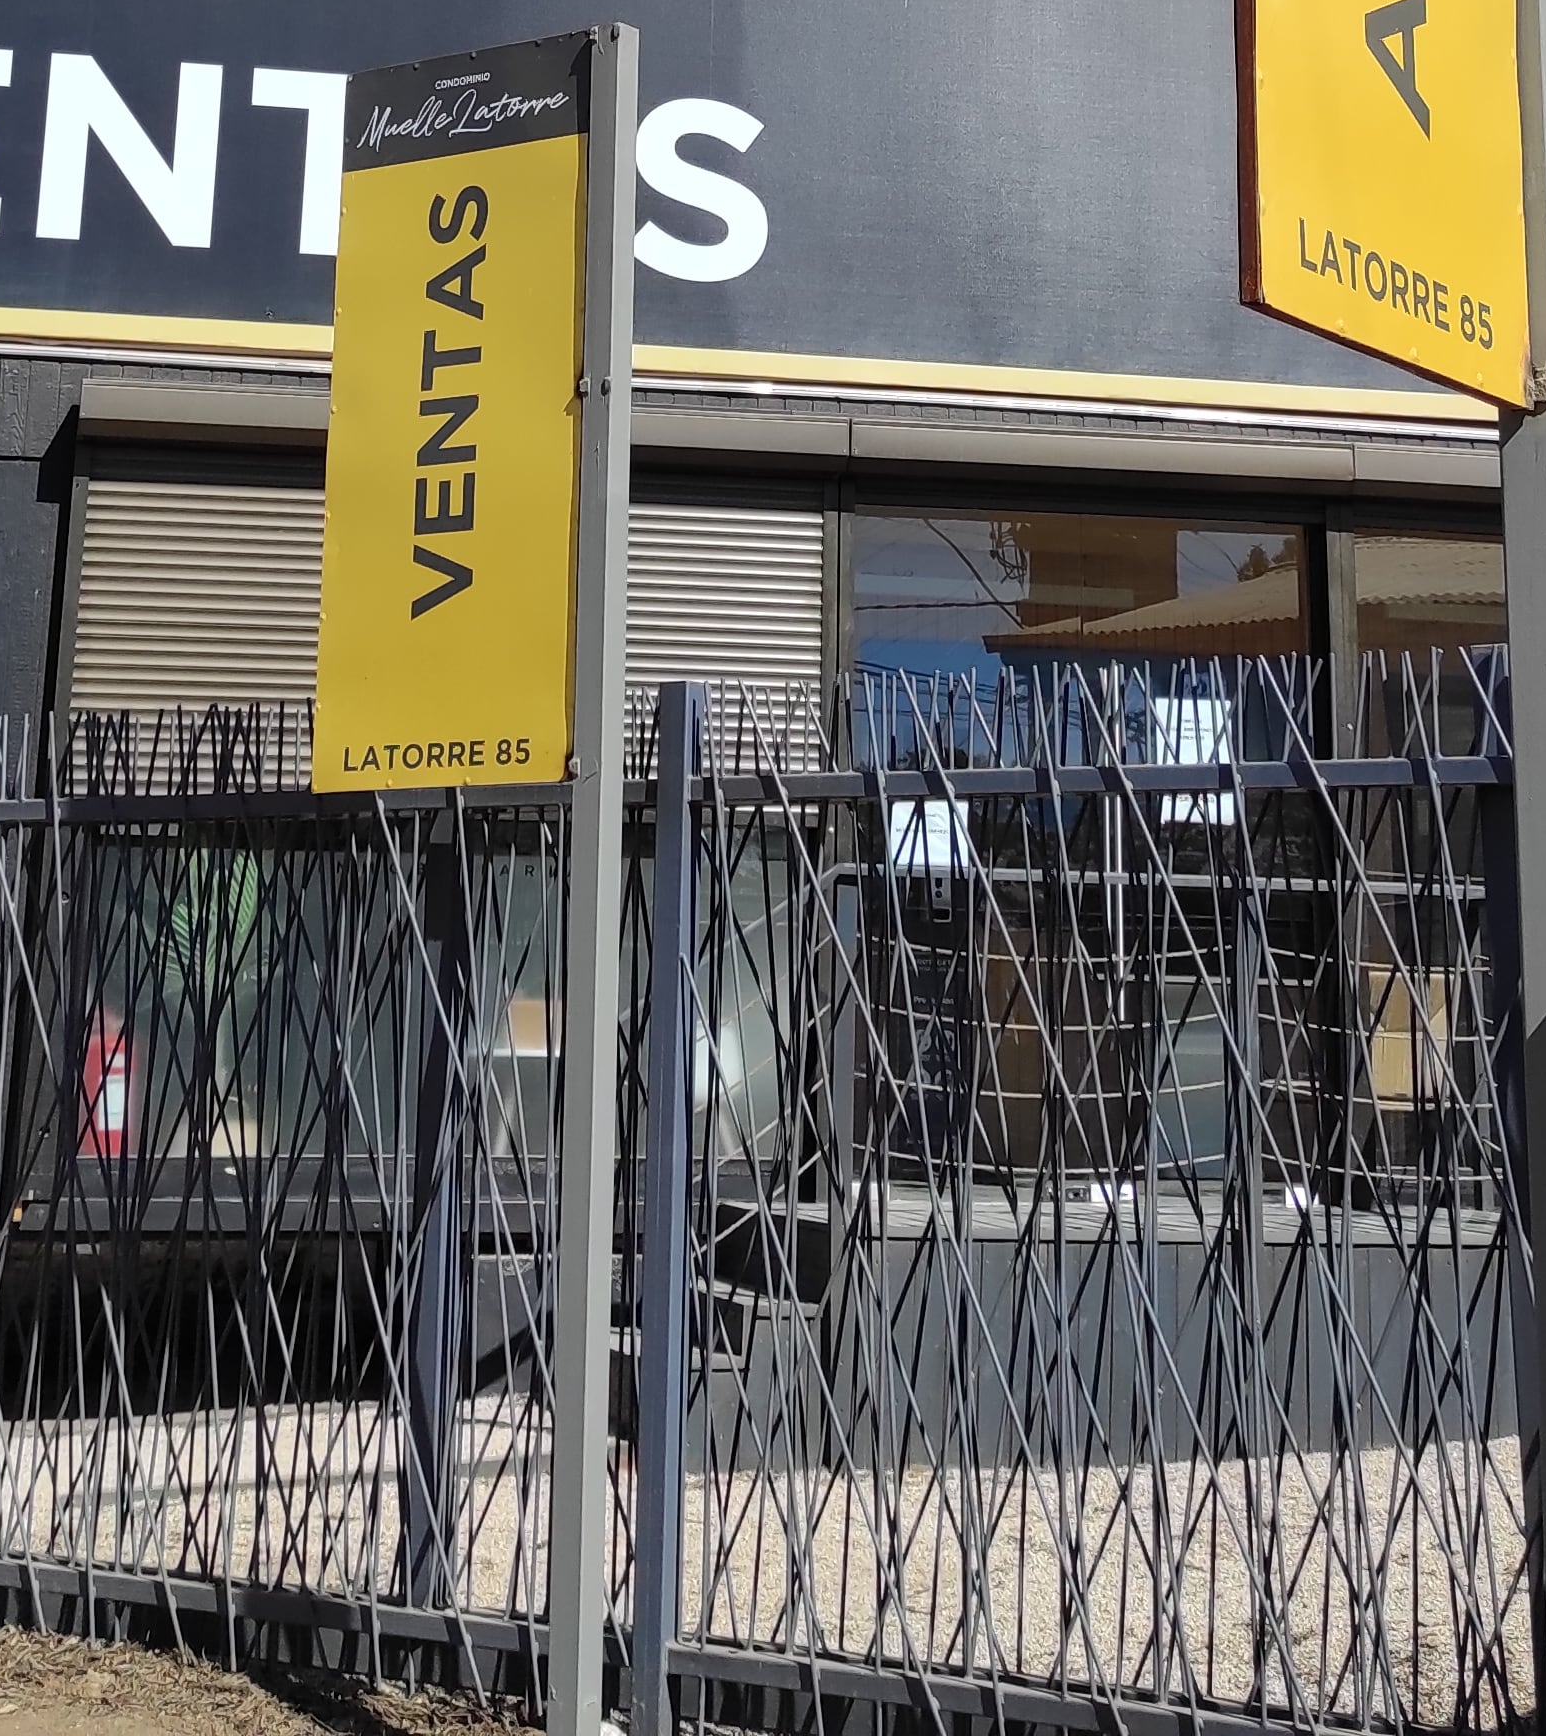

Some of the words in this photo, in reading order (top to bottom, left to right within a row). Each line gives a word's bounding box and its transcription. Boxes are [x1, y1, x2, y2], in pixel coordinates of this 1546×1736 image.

[435, 72, 491, 90] CONDOMINIO
[356, 95, 453, 153] Muelle
[449, 88, 570, 138] Latorre
[1299, 216, 1451, 333] LATORRE
[1460, 294, 1493, 350] 85
[411, 184, 490, 621] VENTAS
[343, 739, 485, 773] LATORRE
[495, 737, 531, 766] 85
